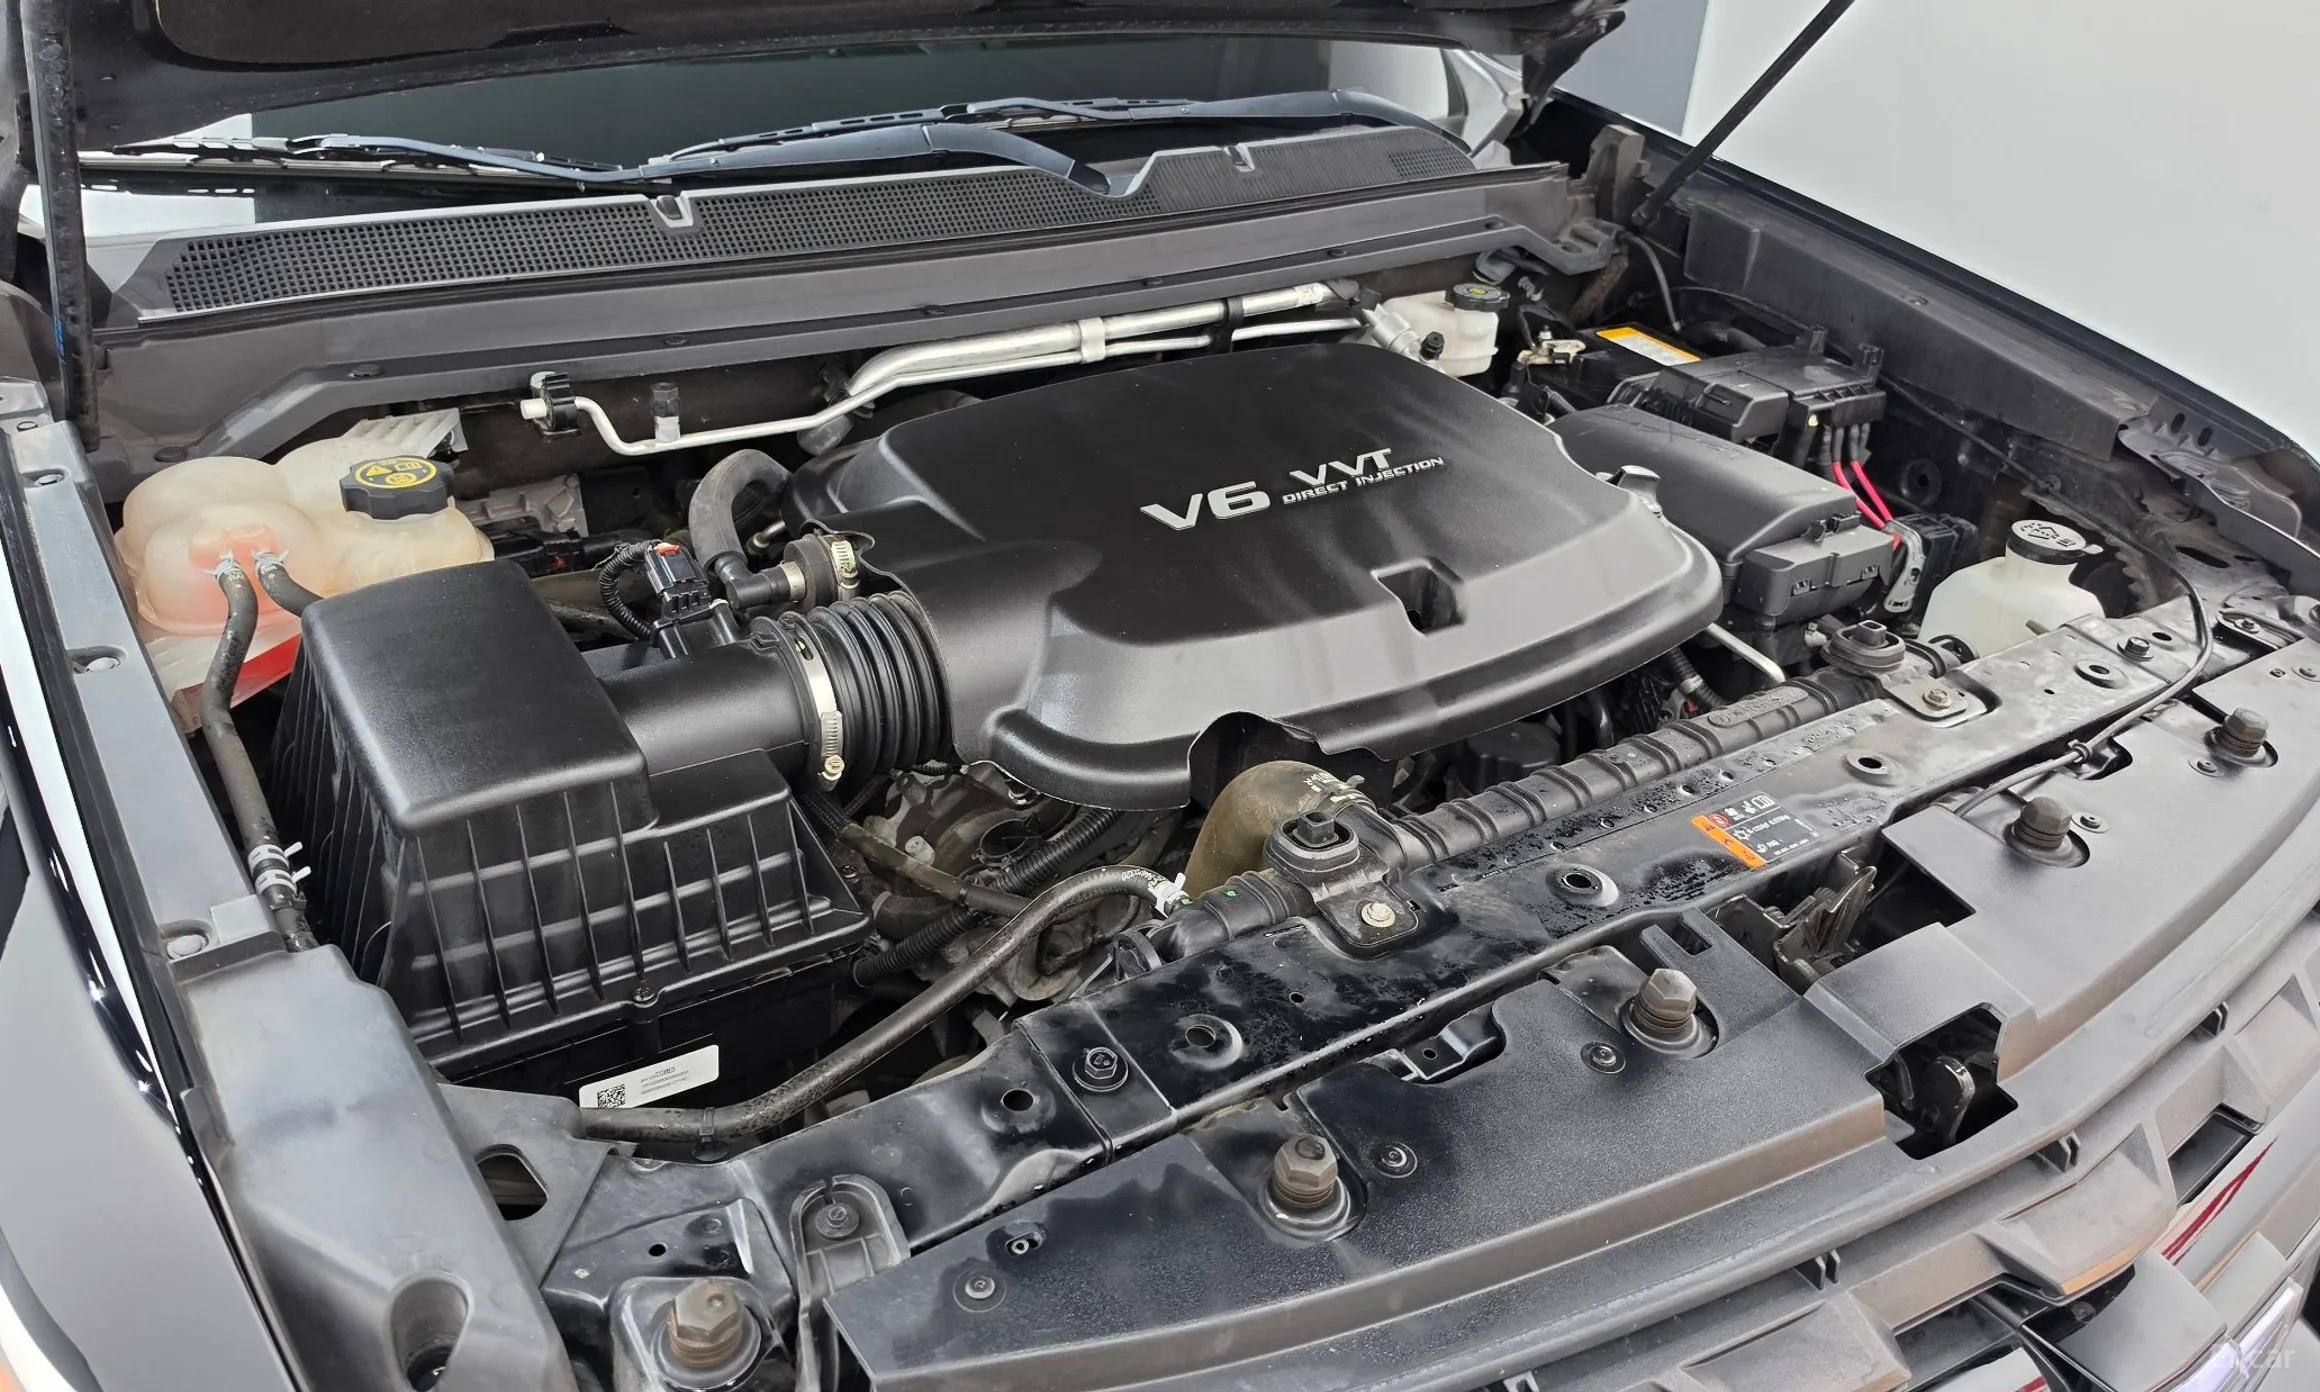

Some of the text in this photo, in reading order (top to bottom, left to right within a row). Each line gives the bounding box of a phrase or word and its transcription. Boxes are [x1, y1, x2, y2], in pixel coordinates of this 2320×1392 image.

[1282, 456, 1444, 504] DIRECT INJECTION
[1289, 447, 1392, 486] VVT
[1140, 481, 1271, 531] V6
